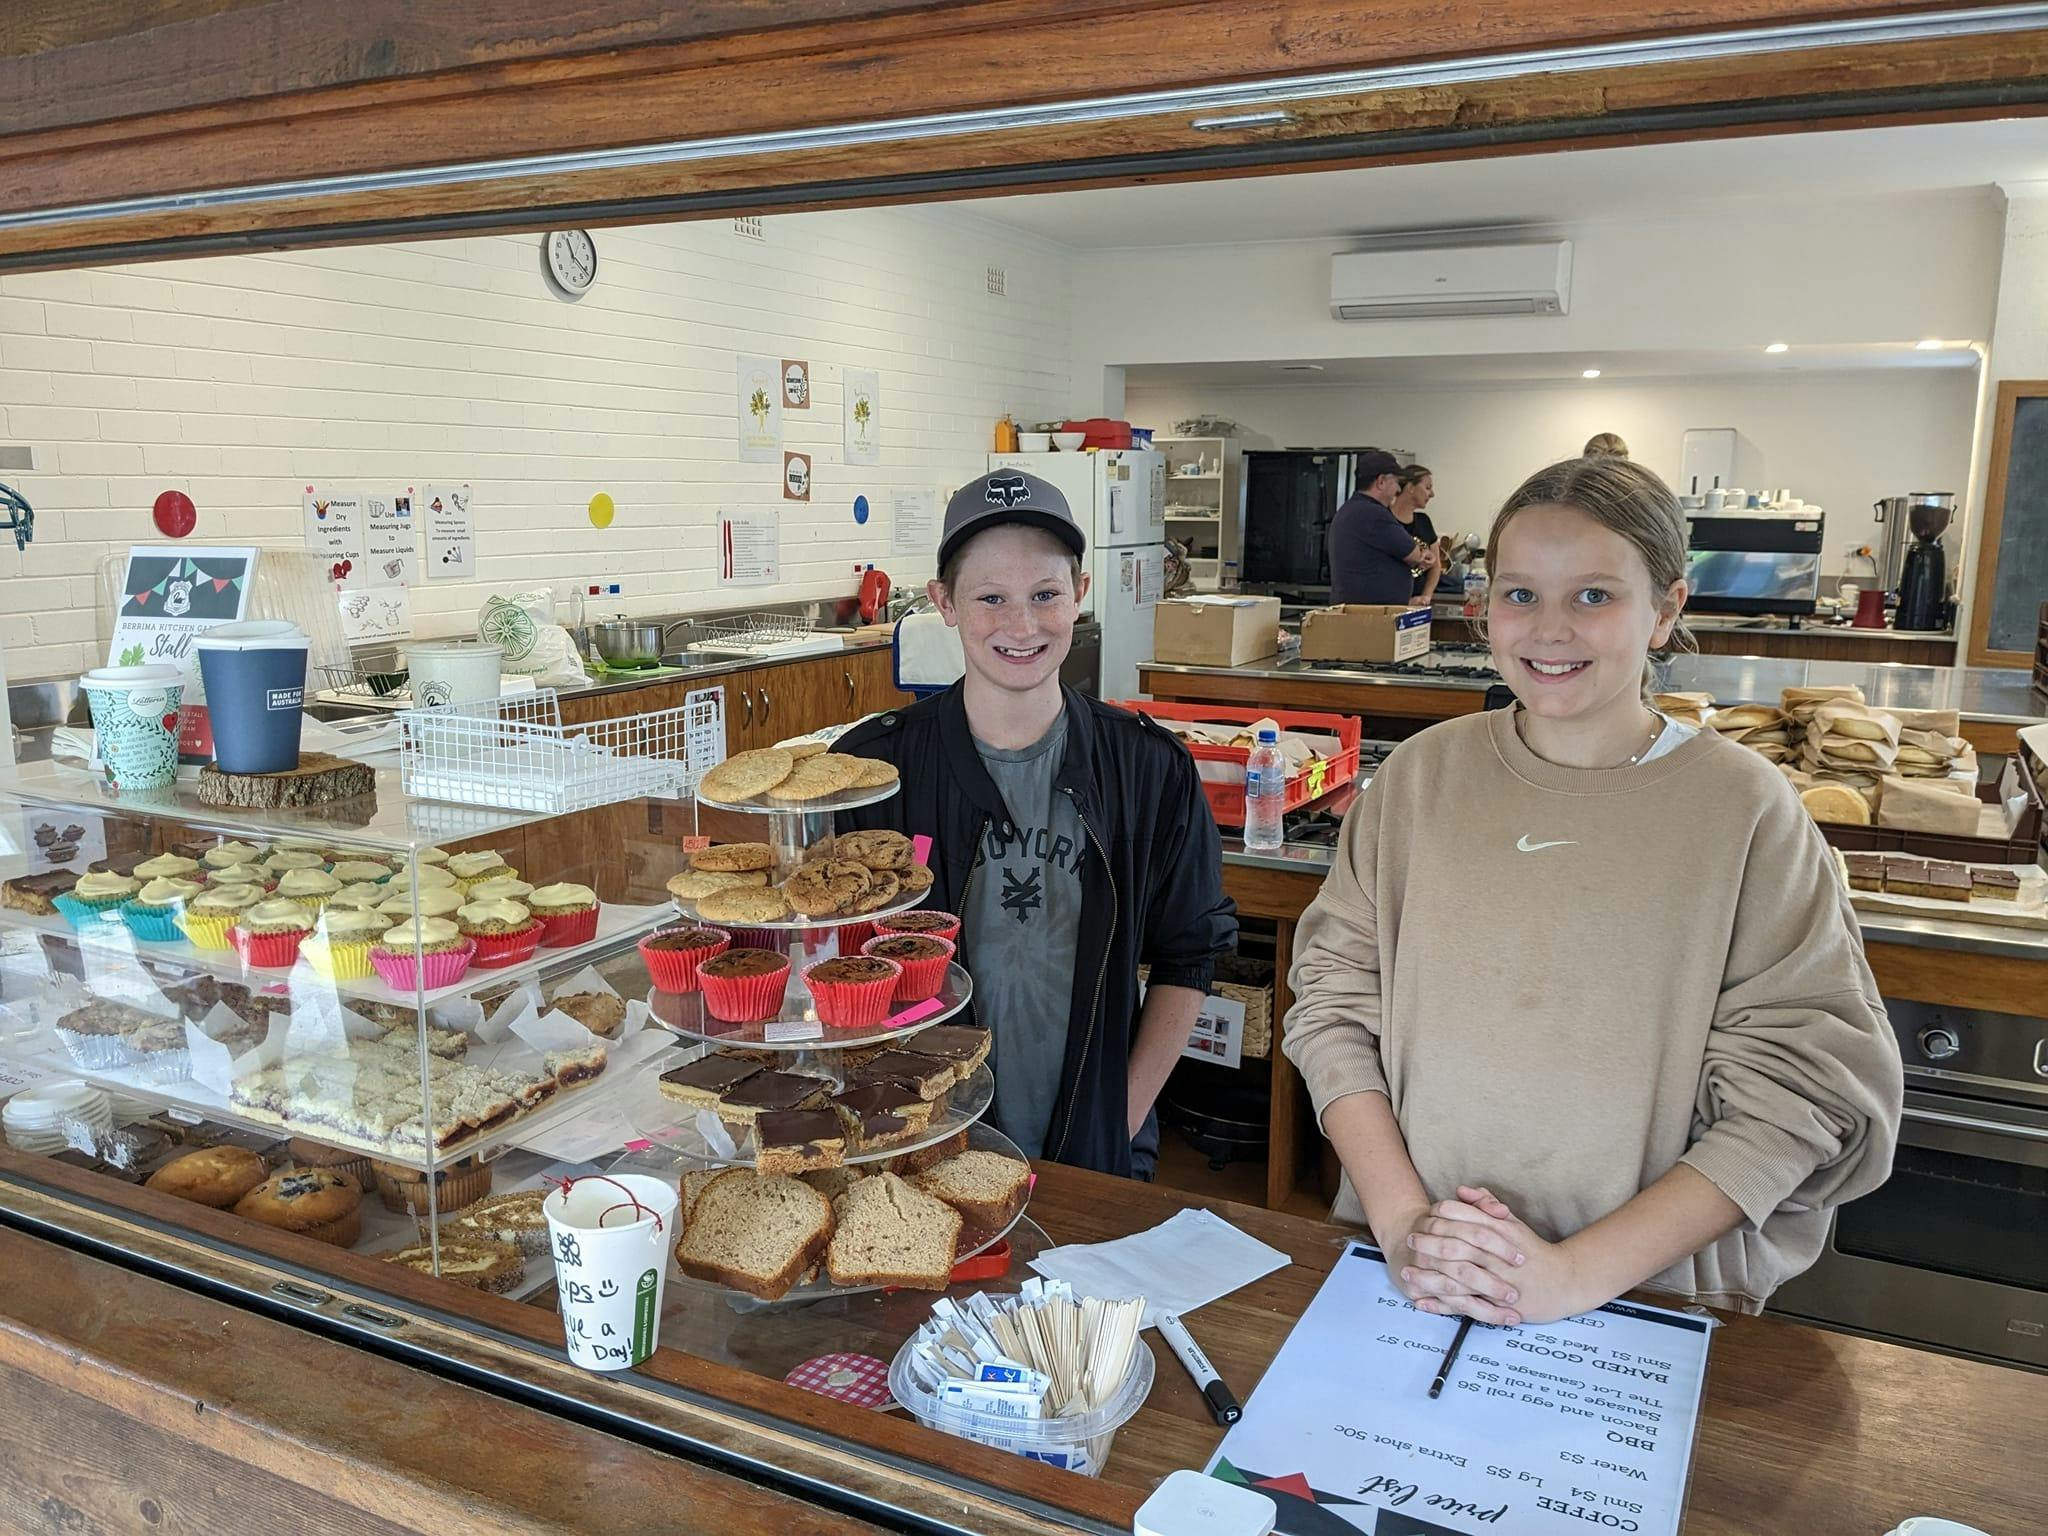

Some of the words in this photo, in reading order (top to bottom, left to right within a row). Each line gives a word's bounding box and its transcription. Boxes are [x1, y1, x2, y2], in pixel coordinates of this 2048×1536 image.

[318, 526, 351, 534] Ingredients
[396, 546, 414, 554] Liquids
[122, 622, 156, 631] BERRIMA
[158, 624, 194, 632] KITCHEN
[150, 633, 194, 659] Stall
[271, 698, 302, 707] AUSTRALIA
[272, 692, 291, 700] MADE
[1377, 1296, 1398, 1308] $4
[602, 1322, 616, 1337] a
[1376, 1333, 1400, 1346] $7
[1534, 1333, 1558, 1344] $2
[1562, 1338, 1600, 1354] Med
[592, 1337, 635, 1363] Day!
[1404, 1339, 1459, 1360] acon)
[1506, 1338, 1584, 1364] GOODS
[1611, 1350, 1632, 1362] $1
[1638, 1356, 1672, 1370] Sml
[1476, 1370, 1500, 1382] $5
[1592, 1358, 1670, 1384] BAKED
[1458, 1380, 1482, 1393] $6
[1504, 1377, 1533, 1390] roll
[1540, 1385, 1550, 1393] a
[1486, 1386, 1516, 1400] roll
[1556, 1388, 1578, 1400] on
[1592, 1384, 1622, 1399] Lot
[1521, 1393, 1554, 1408] egg
[1628, 1392, 1663, 1408] The
[1560, 1404, 1595, 1418] and
[1584, 1396, 1662, 1422] Sausage
[1334, 1424, 1368, 1441] 50c
[1601, 1414, 1658, 1436] Bacon
[1372, 1434, 1413, 1451] shot
[1606, 1430, 1656, 1452] BBQ
[1418, 1446, 1469, 1468] Extra
[1560, 1450, 1585, 1465] $3
[1486, 1464, 1512, 1480] $5
[1590, 1458, 1648, 1482] Water
[1518, 1470, 1544, 1488] Lg
[1357, 1475, 1419, 1506] list
[1570, 1486, 1597, 1502] $4
[1424, 1494, 1509, 1524] price
[1603, 1495, 1643, 1514] Sml
[1536, 1496, 1639, 1532] COFFEE
